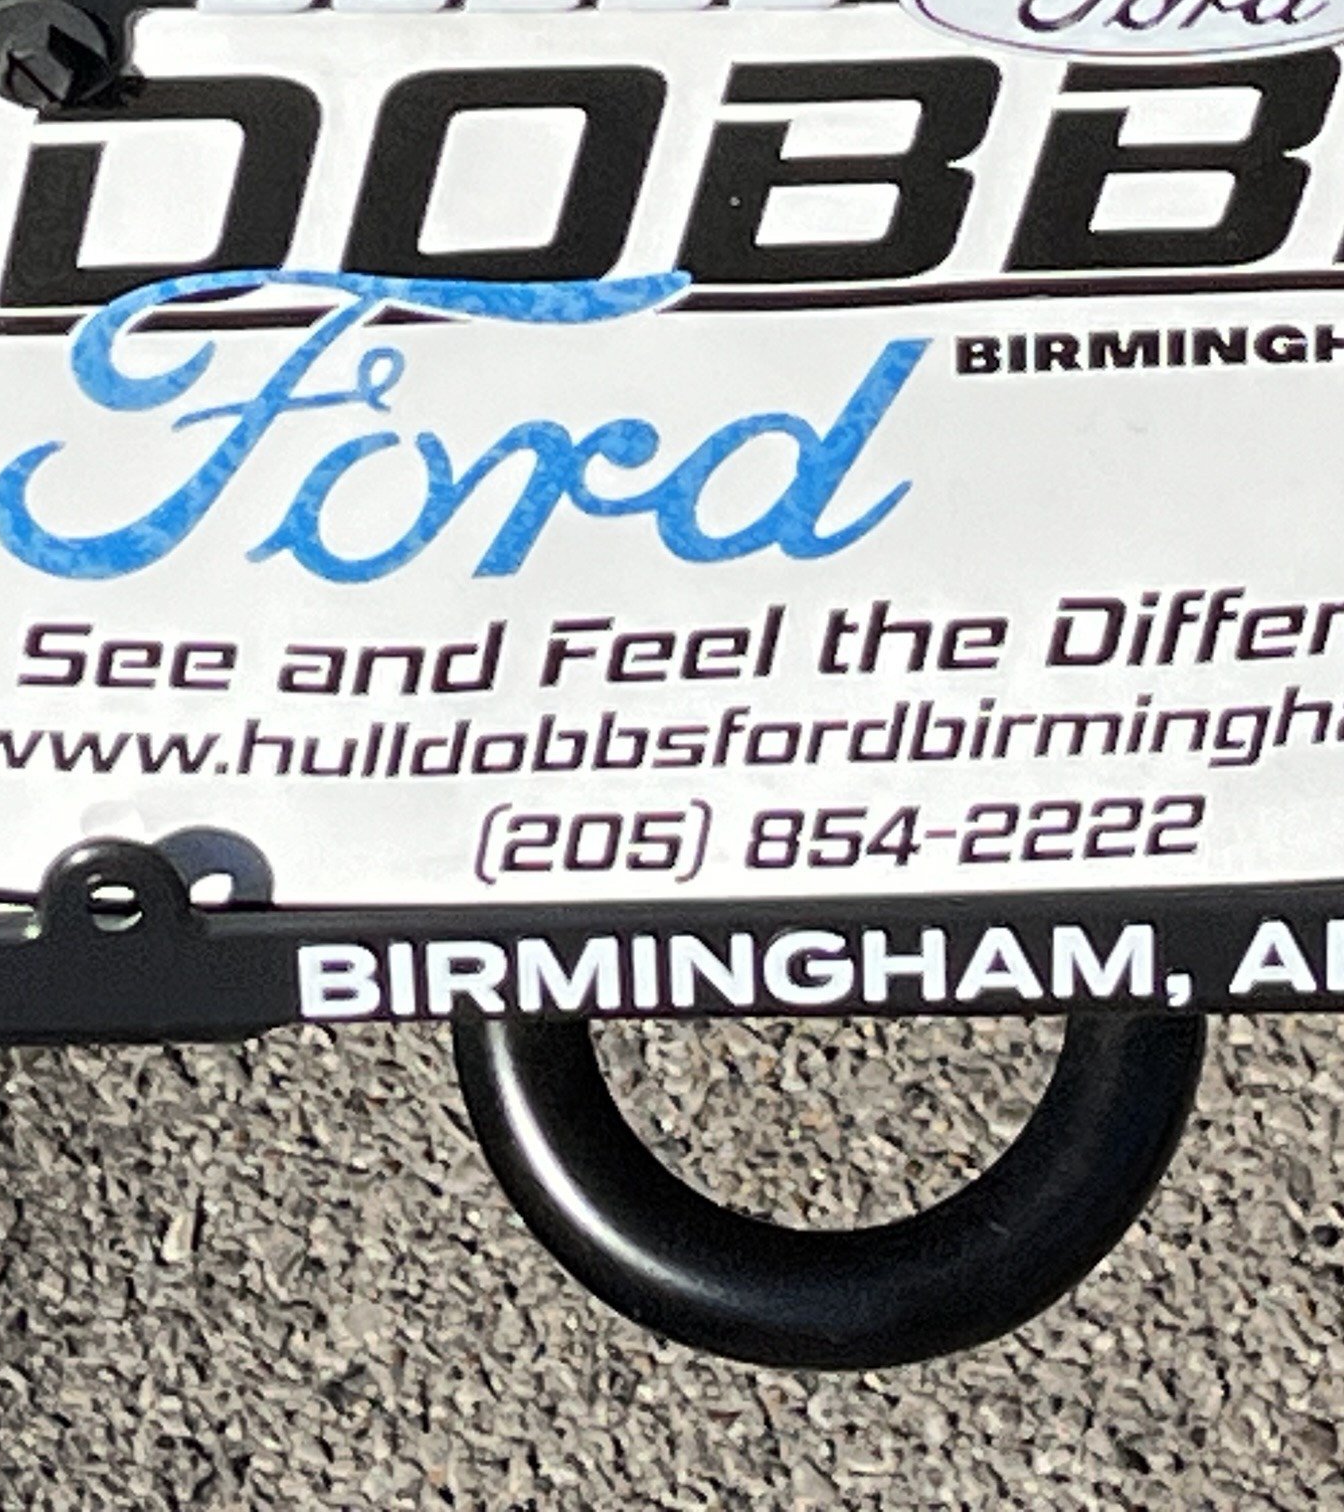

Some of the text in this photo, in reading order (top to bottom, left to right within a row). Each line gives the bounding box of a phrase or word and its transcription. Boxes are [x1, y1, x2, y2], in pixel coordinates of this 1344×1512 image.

[19, 622, 237, 690] See
[277, 622, 507, 694] and
[540, 606, 785, 687] Feel
[817, 600, 1008, 674] the
[476, 794, 1207, 884] (205) 854-2222
[296, 924, 1194, 1018] BIRMINGHAM,
